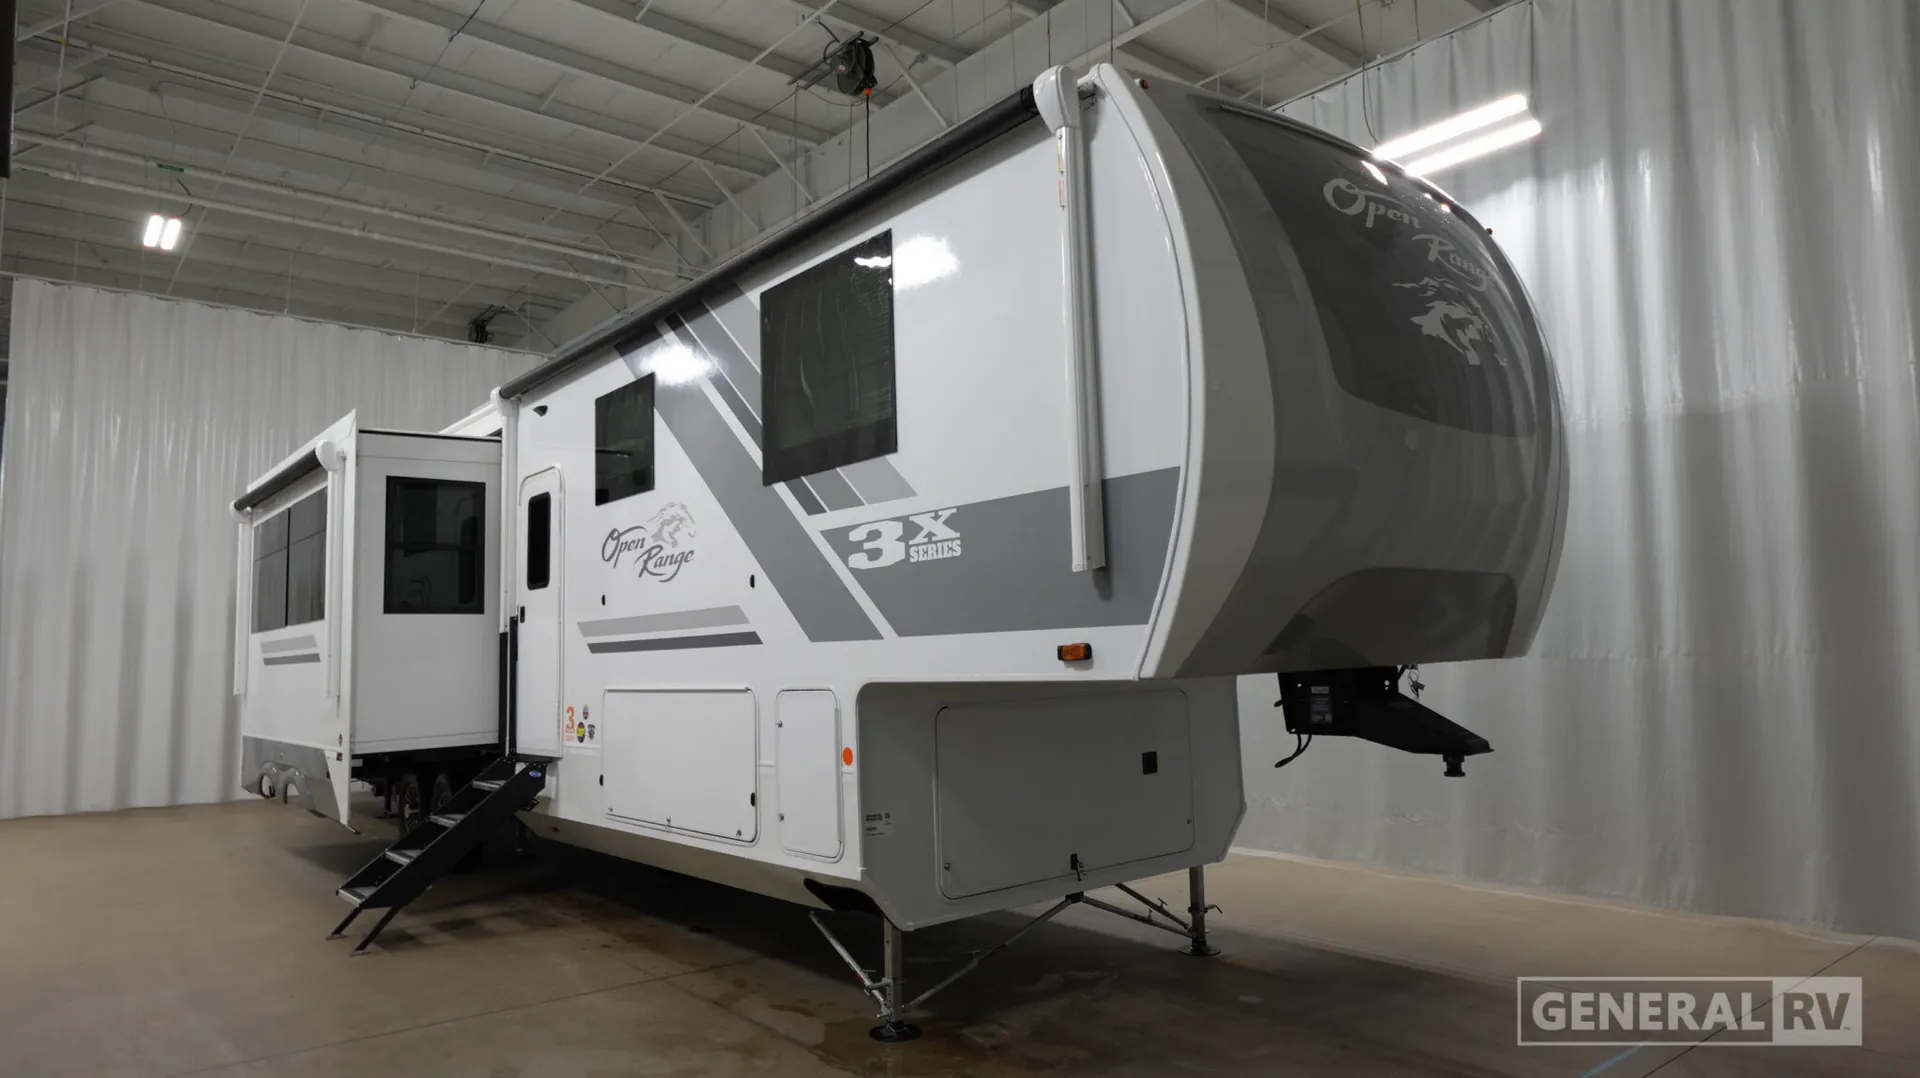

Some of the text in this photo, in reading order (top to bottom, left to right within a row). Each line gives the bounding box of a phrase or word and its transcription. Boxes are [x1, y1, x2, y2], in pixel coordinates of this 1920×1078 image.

[1323, 178, 1421, 228] Open
[602, 525, 648, 569] Open
[633, 544, 695, 583] Range
[909, 540, 962, 563] SERIES
